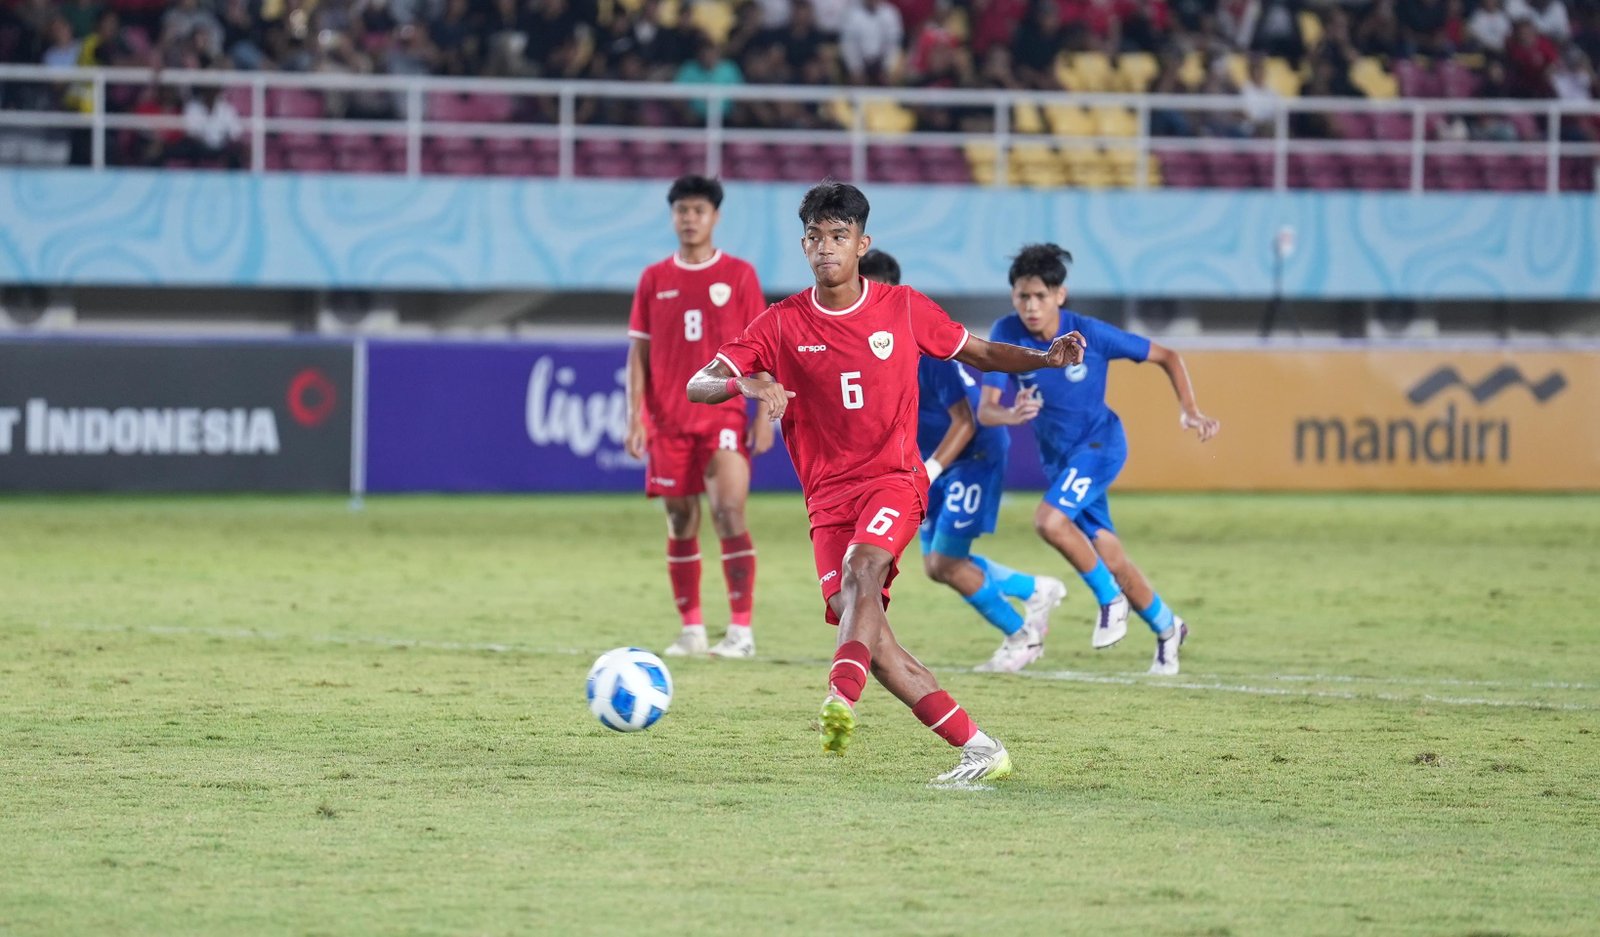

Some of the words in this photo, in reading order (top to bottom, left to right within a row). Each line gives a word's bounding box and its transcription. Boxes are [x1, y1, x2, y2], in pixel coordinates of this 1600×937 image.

[684, 309, 703, 342] 8
[798, 344, 827, 353] erspo
[525, 355, 628, 456] livi
[840, 371, 864, 410] 6
[26, 398, 280, 454] INDONESIA
[1295, 402, 1510, 463] mandiri
[946, 481, 982, 514] 20
[1061, 467, 1092, 502] 14
[866, 506, 900, 536] 6
[819, 569, 837, 585] rspo
